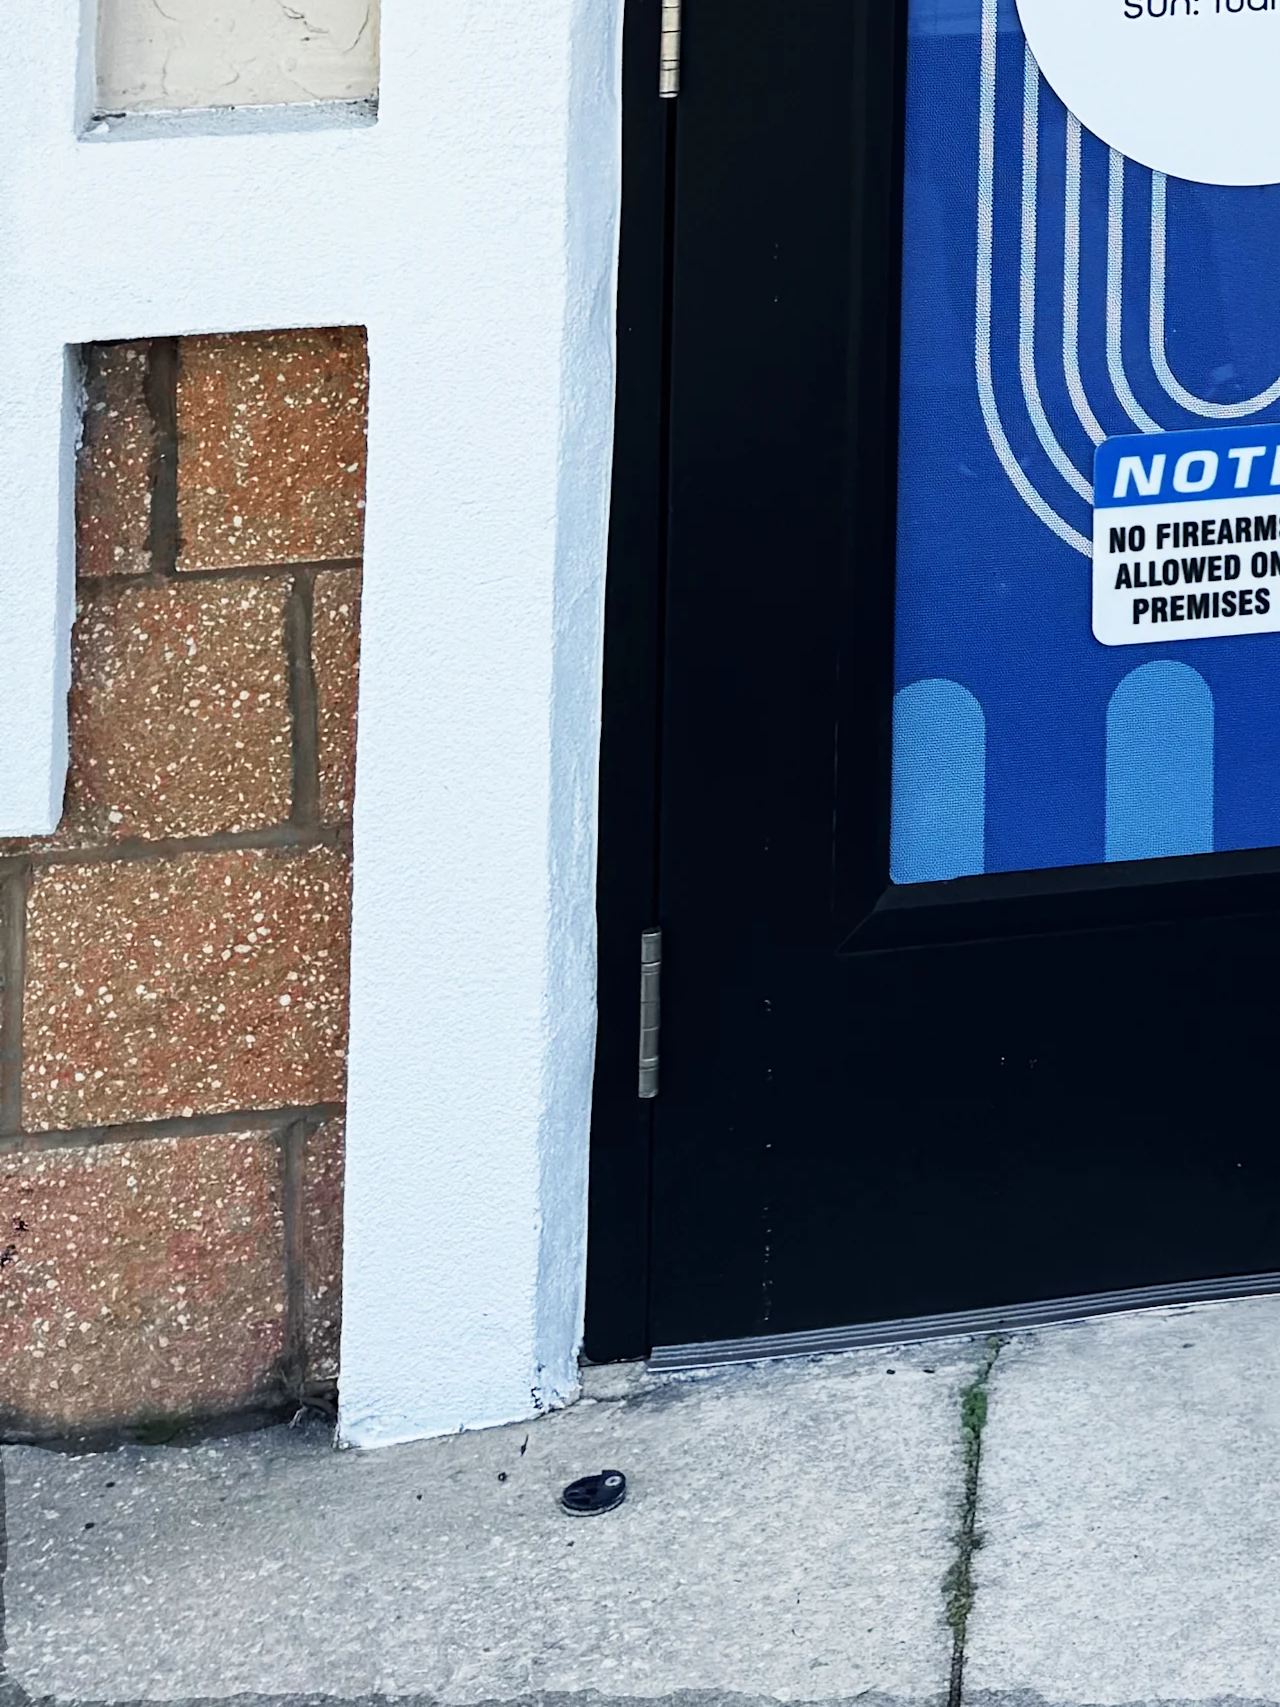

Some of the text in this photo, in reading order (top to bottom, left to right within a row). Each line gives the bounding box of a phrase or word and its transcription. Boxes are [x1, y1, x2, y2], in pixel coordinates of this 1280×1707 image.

[1108, 524, 1147, 555] NO
[1113, 554, 1242, 591] ALLOWED
[1131, 586, 1271, 626] PREMISES
